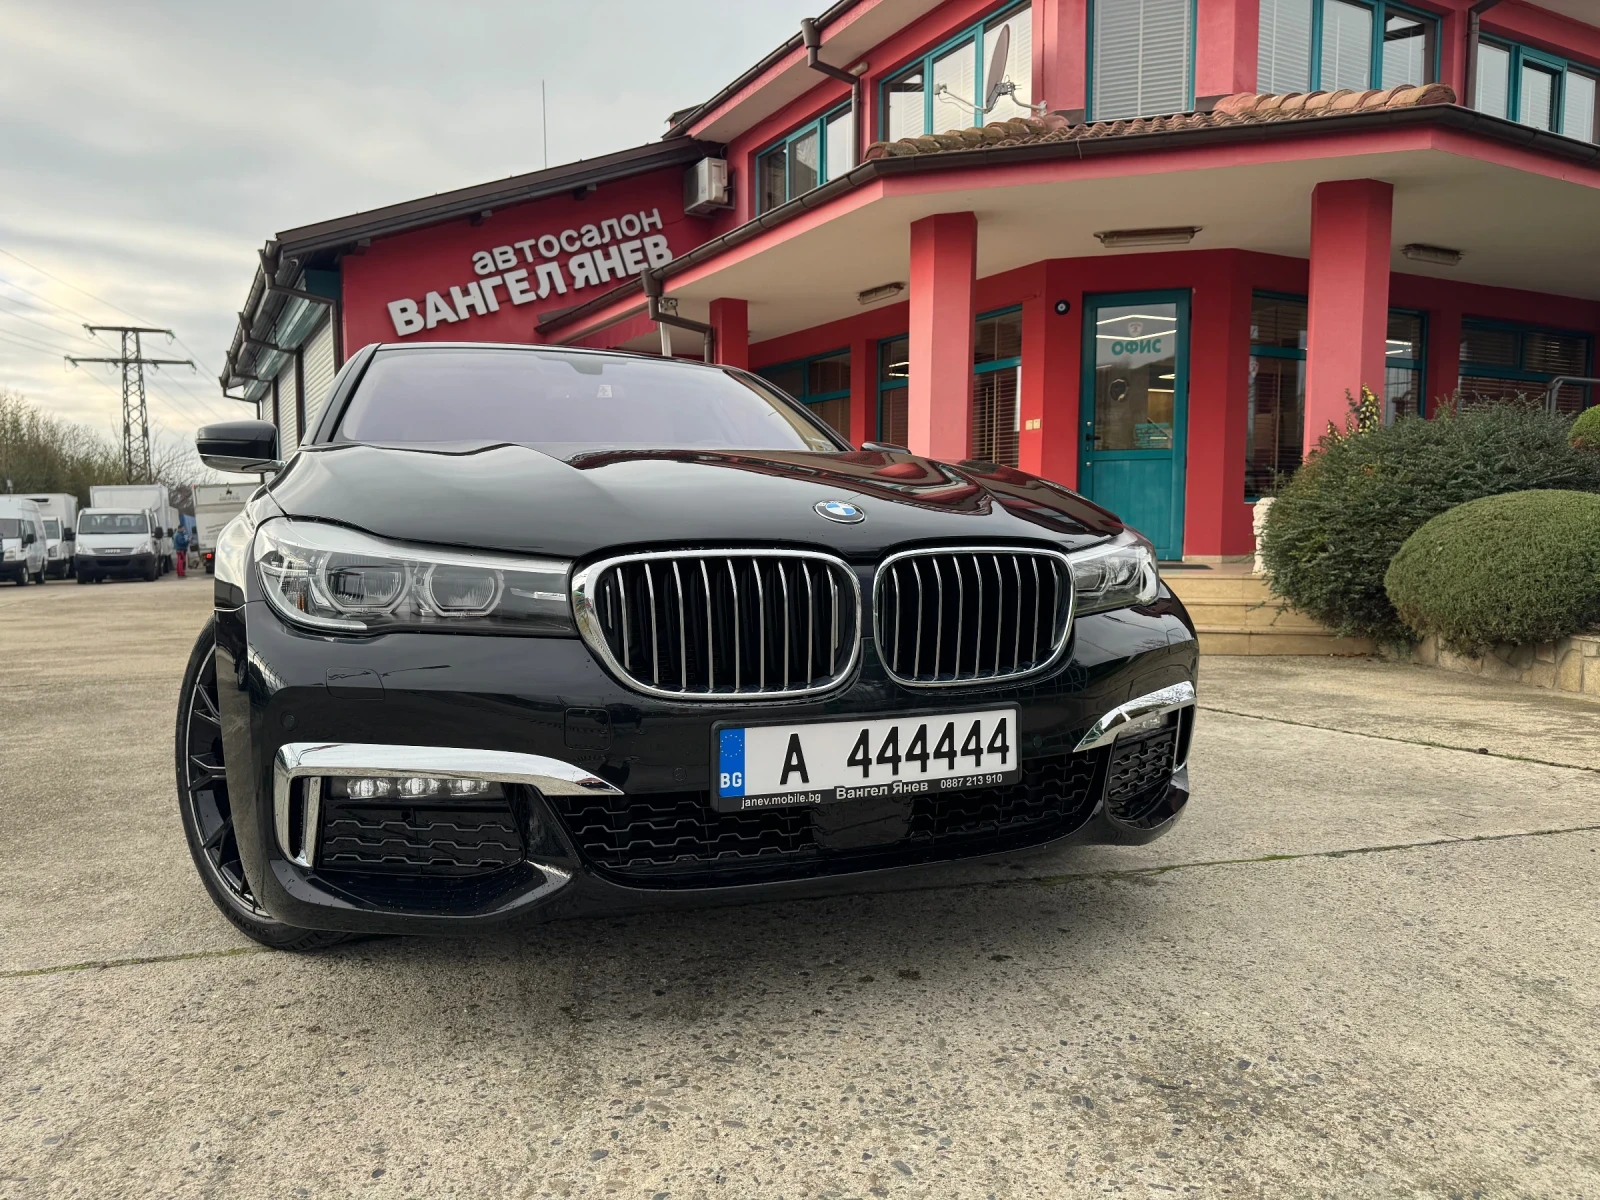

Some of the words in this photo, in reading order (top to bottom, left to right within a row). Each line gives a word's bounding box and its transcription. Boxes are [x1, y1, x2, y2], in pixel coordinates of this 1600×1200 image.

[472, 208, 663, 275] автосалон
[387, 261, 567, 336] ВАНГЕЛ
[568, 234, 673, 289] ЯНЕВ
[1111, 338, 1162, 356] ОФИС
[779, 733, 810, 785] A
[847, 717, 1010, 778] 444444
[720, 772, 742, 789] BG
[940, 777, 963, 789] 0887
[966, 775, 984, 786] 213
[986, 773, 1003, 785] 910
[836, 786, 888, 800] Вангел
[892, 781, 929, 794] Янев
[741, 792, 821, 809] janev.mobile.bg
